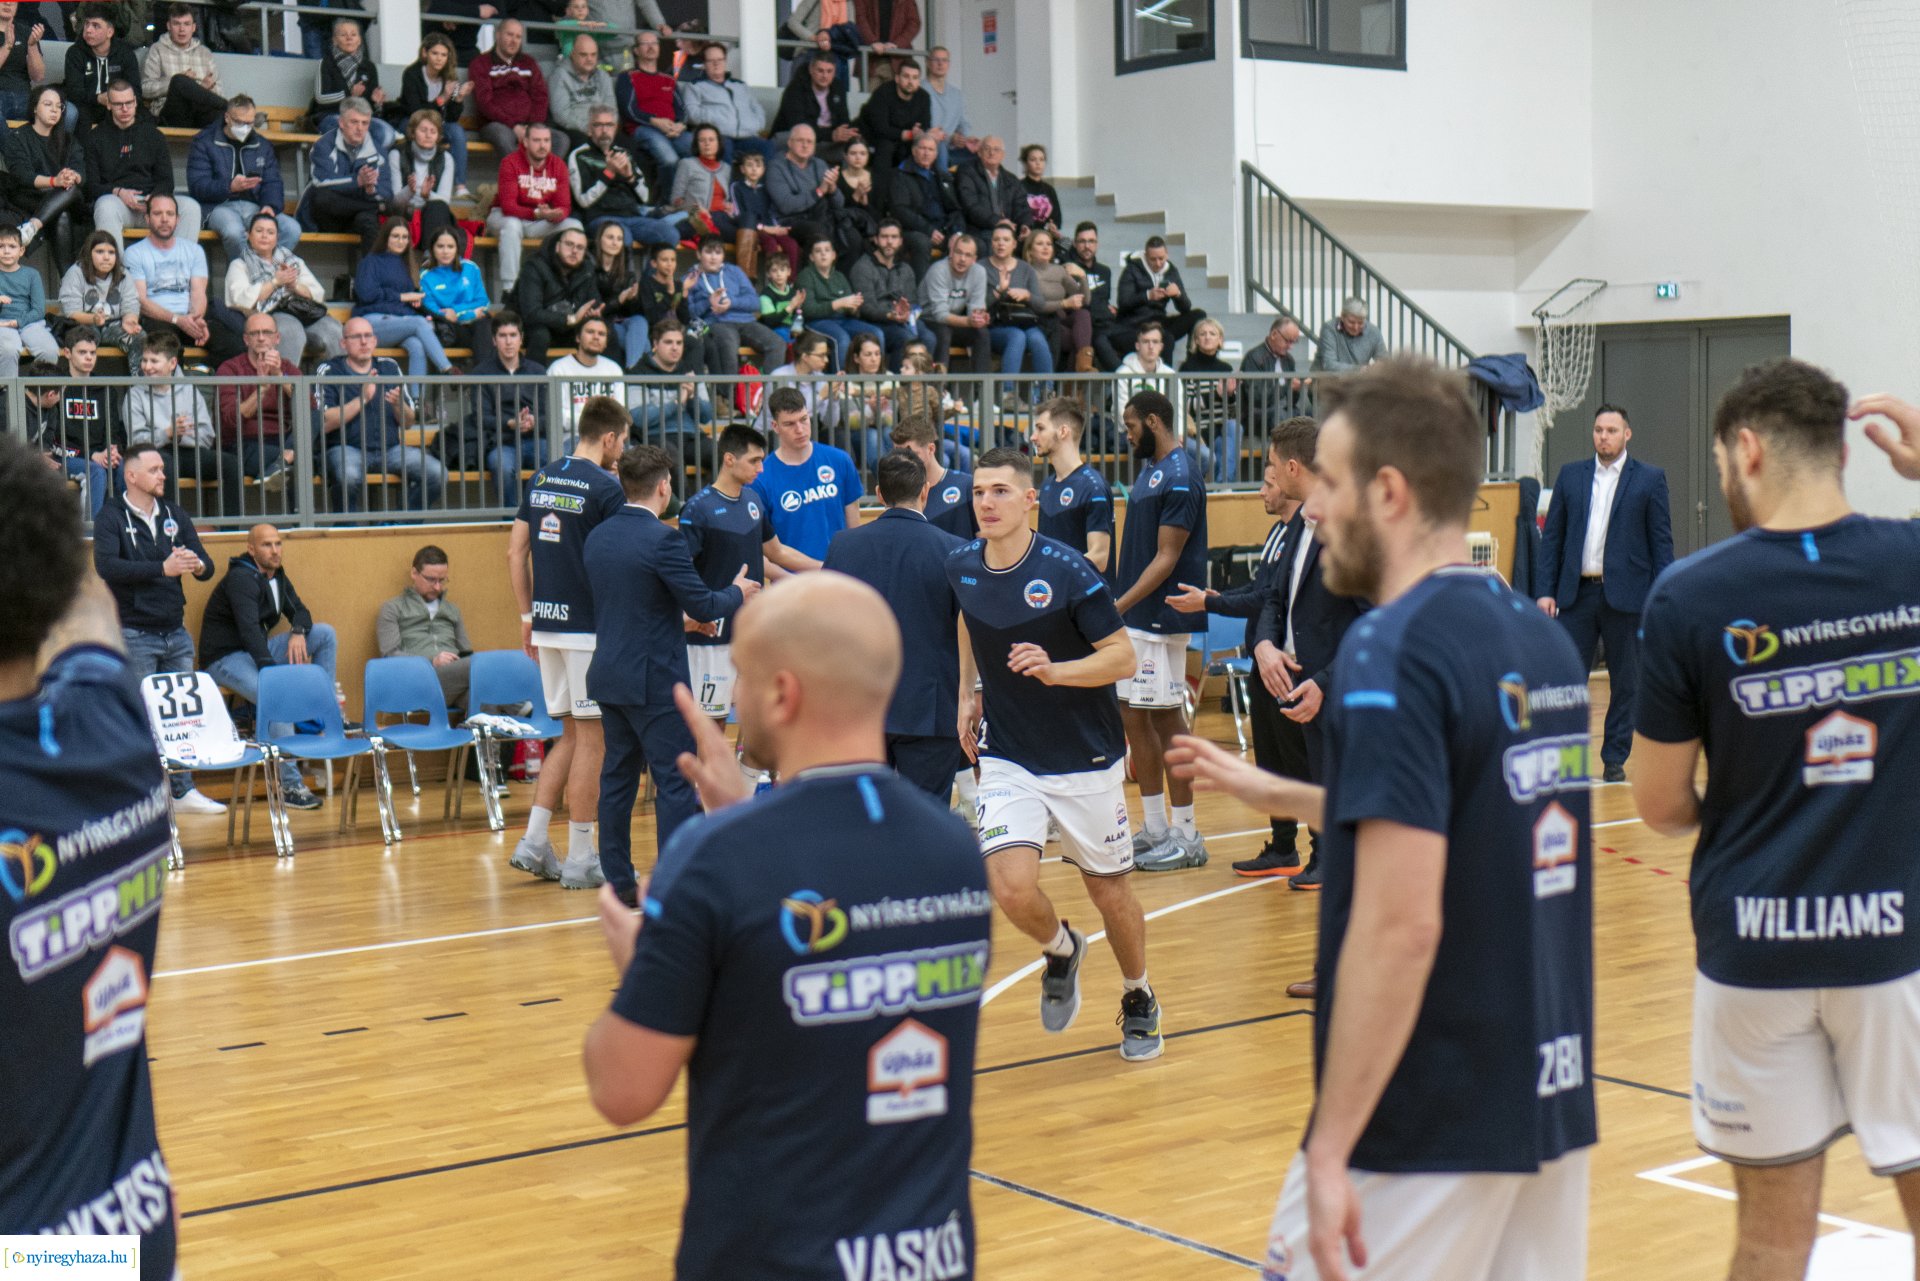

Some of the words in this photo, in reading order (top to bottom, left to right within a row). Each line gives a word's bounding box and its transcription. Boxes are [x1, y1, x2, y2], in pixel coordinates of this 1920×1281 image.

[546, 476, 589, 490] NYÍREGYHÁZA
[803, 483, 838, 504] JAKO
[960, 576, 977, 586] JAKO
[152, 673, 203, 719] 33
[700, 683, 716, 703] 17
[1735, 890, 1905, 939] WILLIAMS
[835, 1208, 968, 1281] VASKÓ
